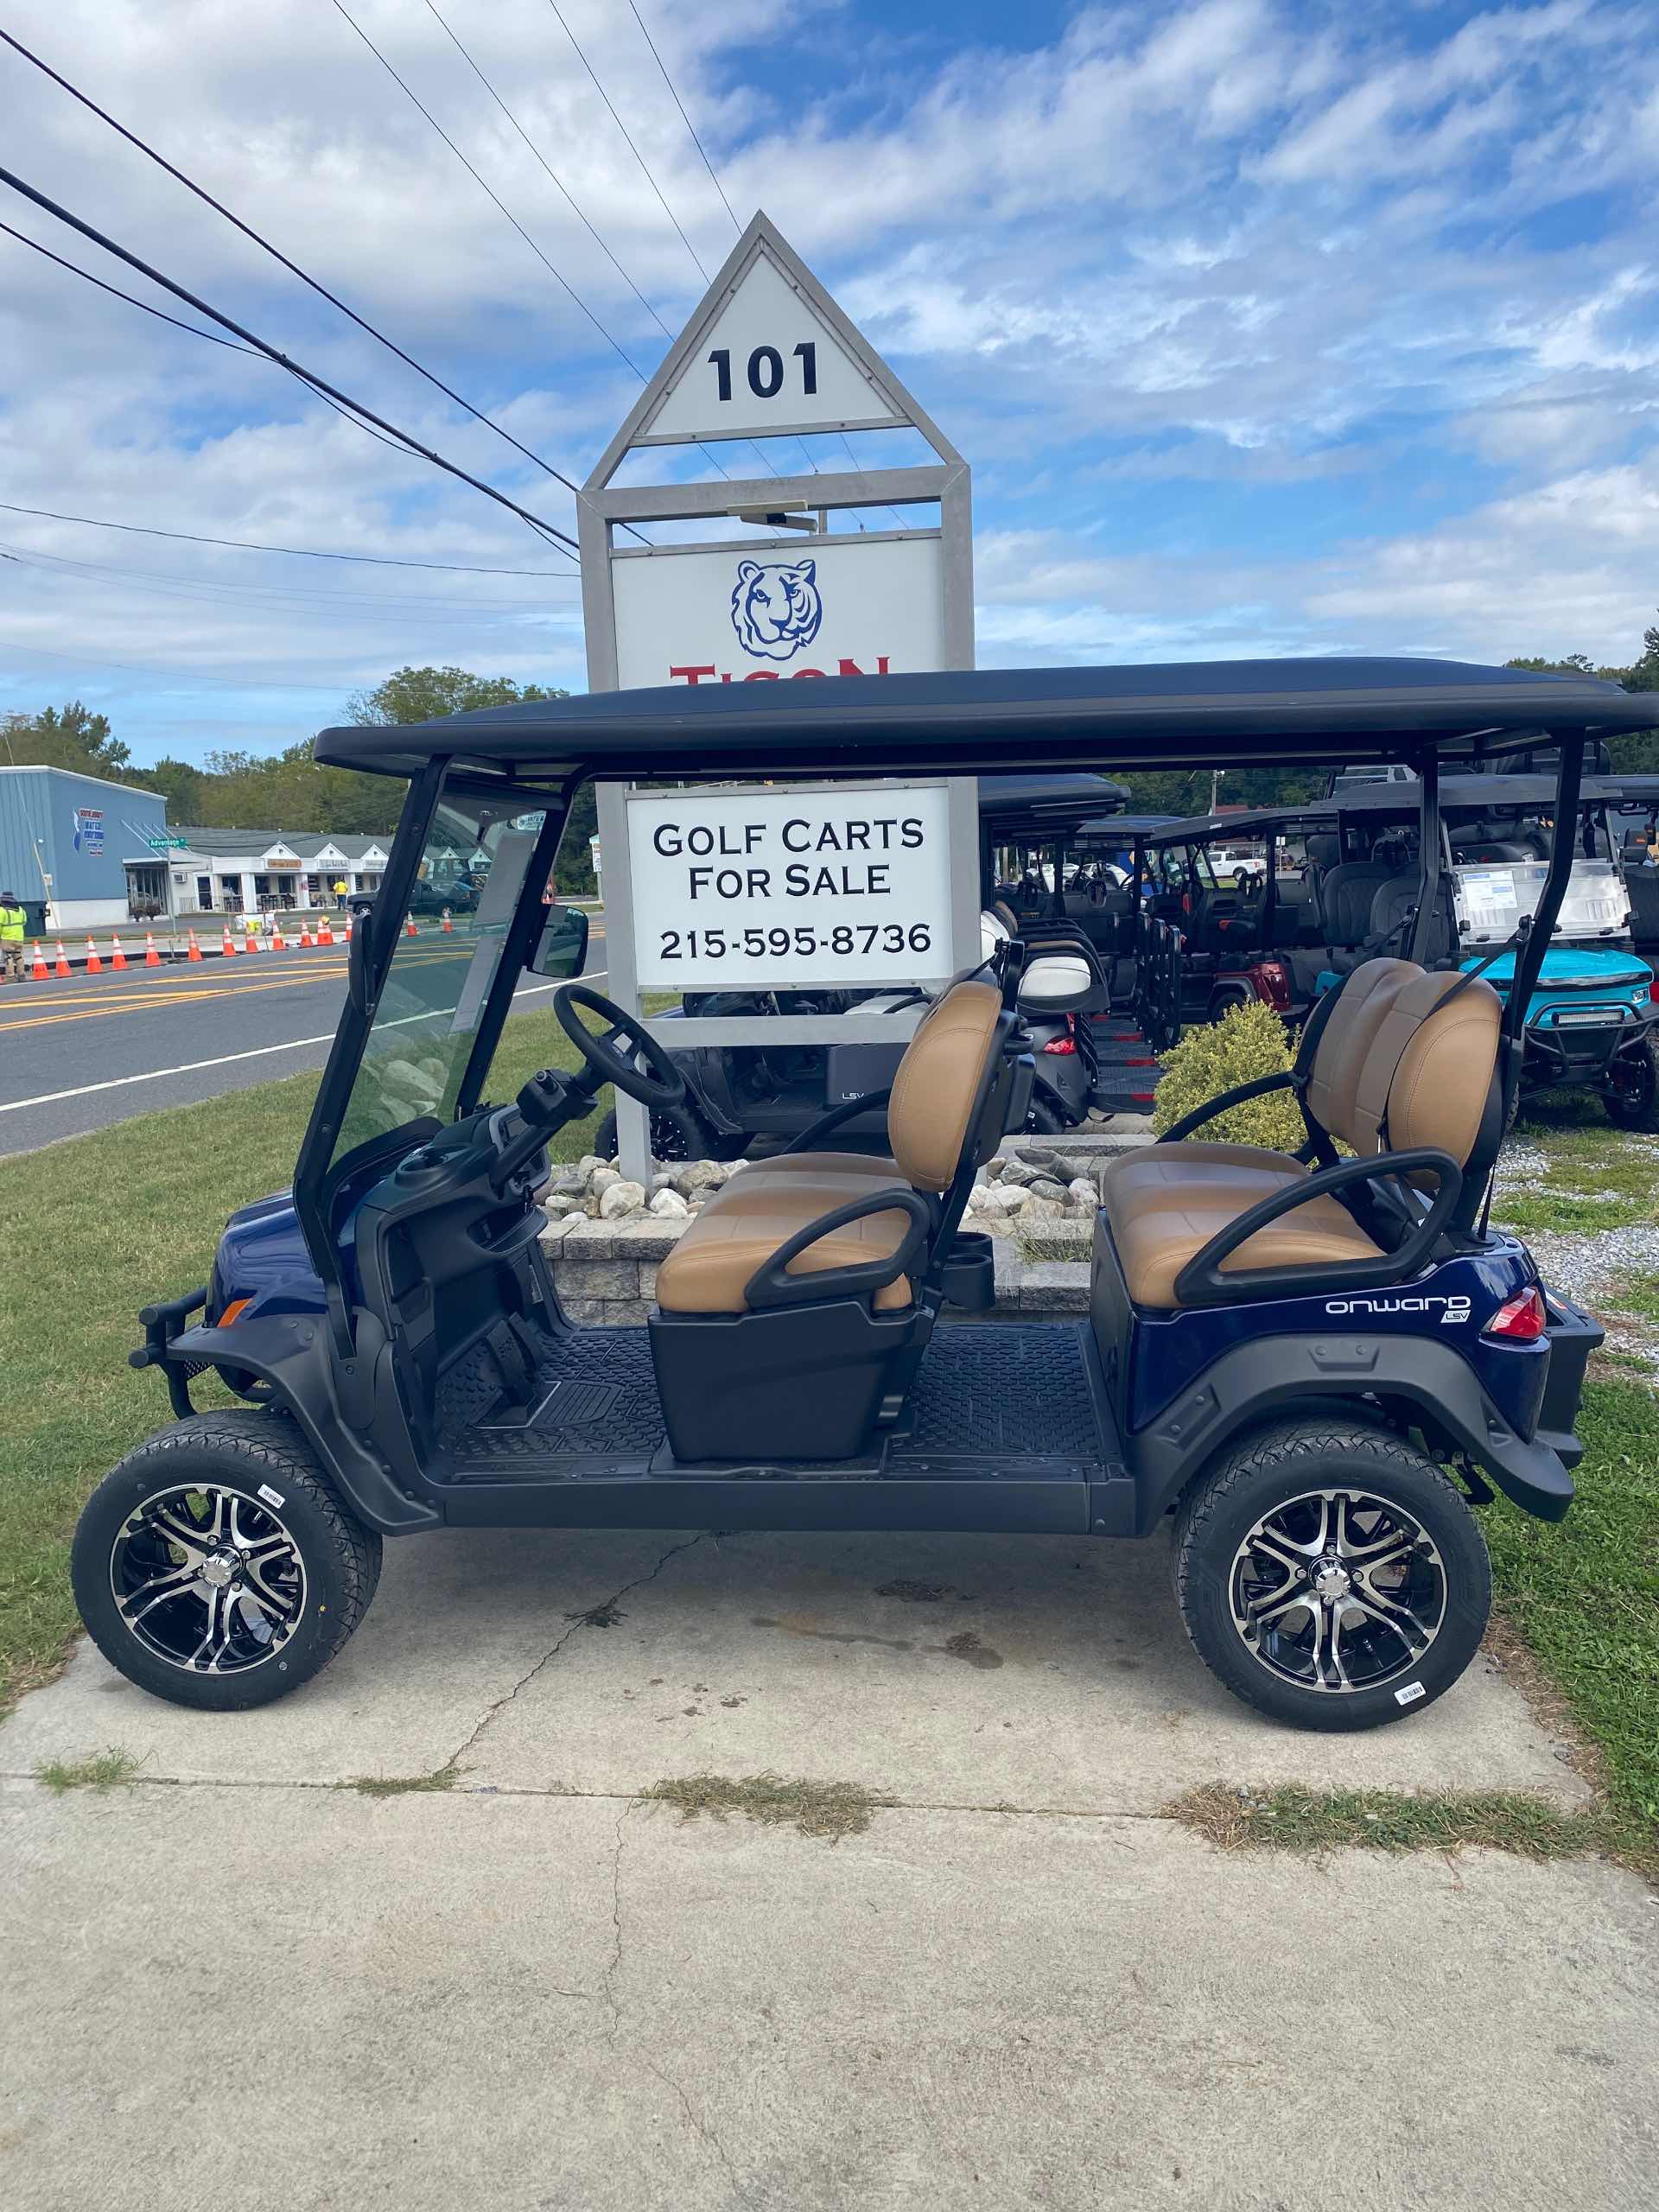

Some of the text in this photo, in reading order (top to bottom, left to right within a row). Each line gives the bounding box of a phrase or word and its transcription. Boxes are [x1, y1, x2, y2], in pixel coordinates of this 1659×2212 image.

[707, 341, 817, 401] 101
[653, 817, 924, 857] GOLF CARTS
[689, 863, 891, 899] FOR SALE
[660, 923, 931, 960] 215-595-8736
